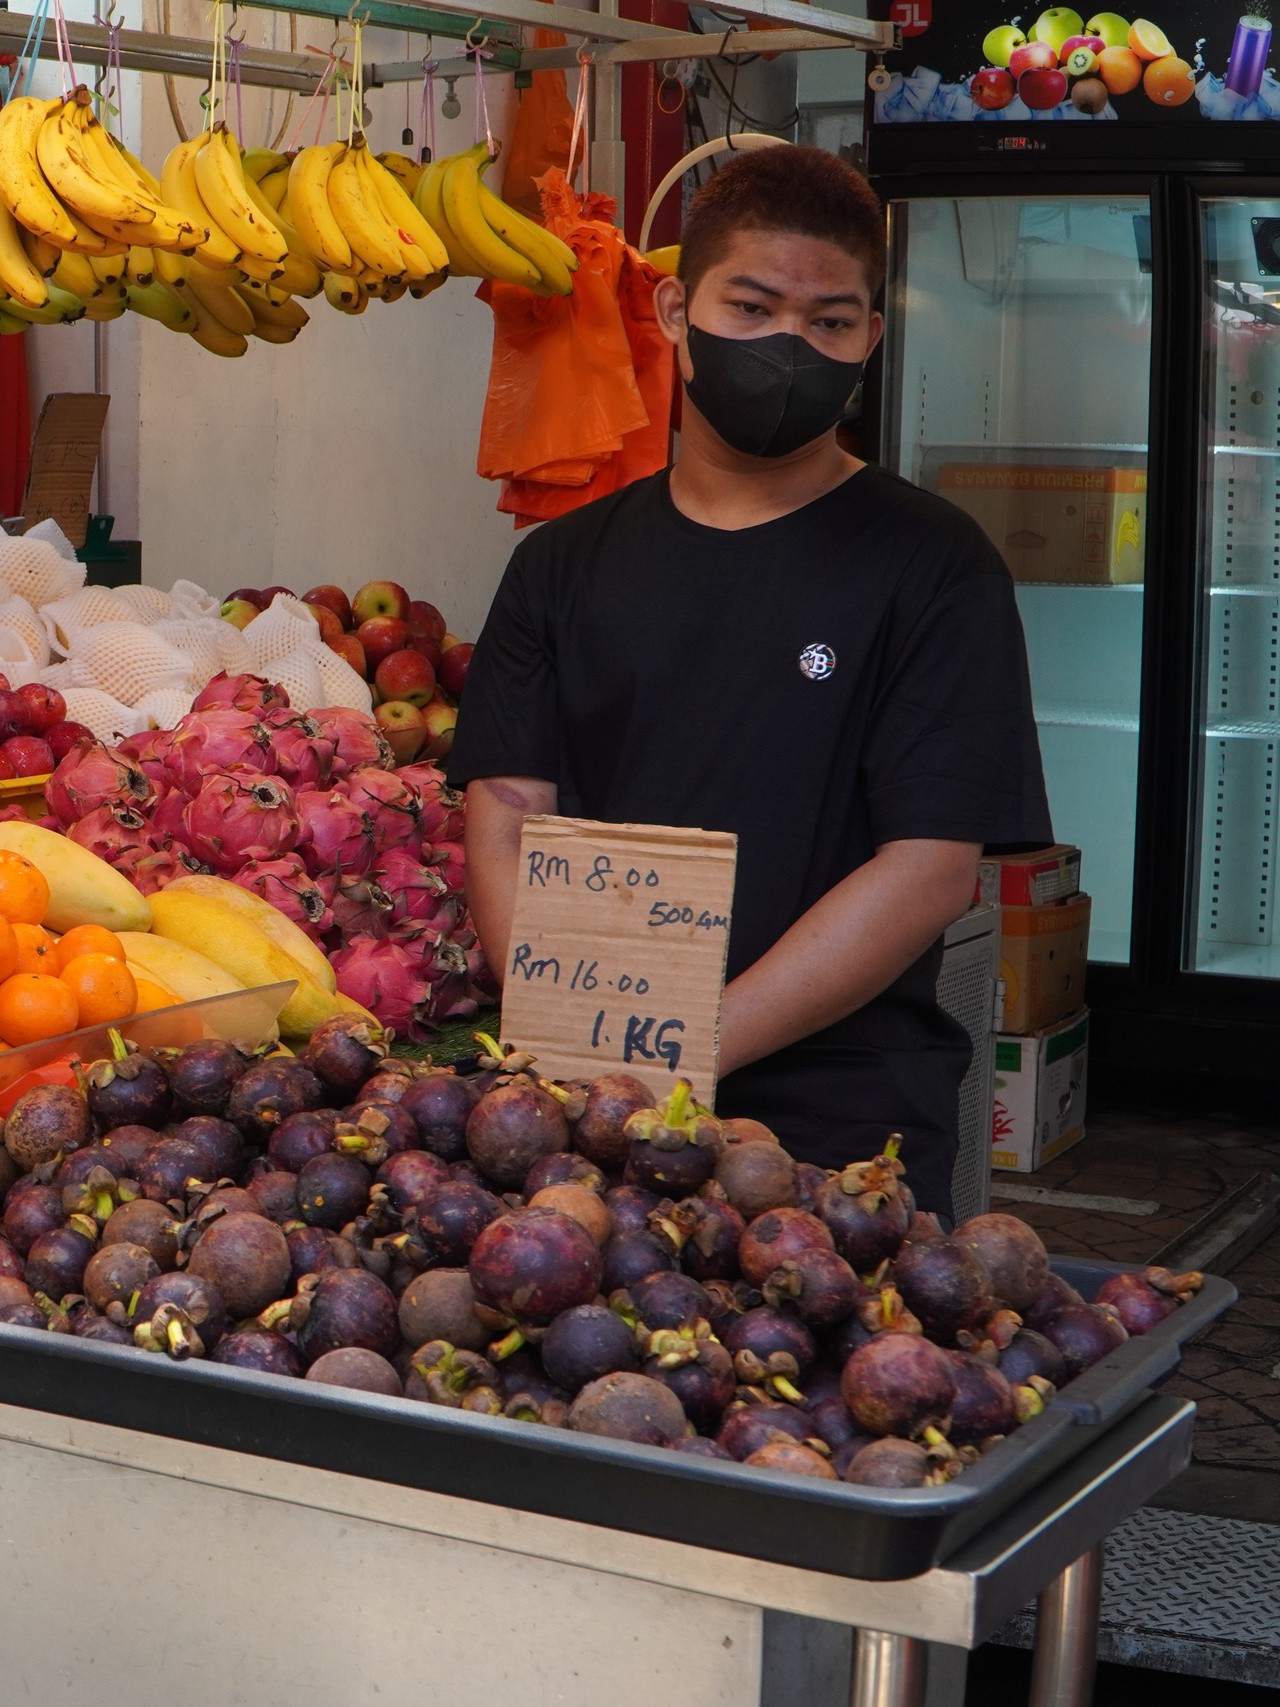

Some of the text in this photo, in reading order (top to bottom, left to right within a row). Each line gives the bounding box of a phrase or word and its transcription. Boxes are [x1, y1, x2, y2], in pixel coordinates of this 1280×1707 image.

[955, 470, 1106, 488] PREMIUM BANANAS
[584, 855, 660, 892] 8.00
[570, 959, 650, 995] 16.00
